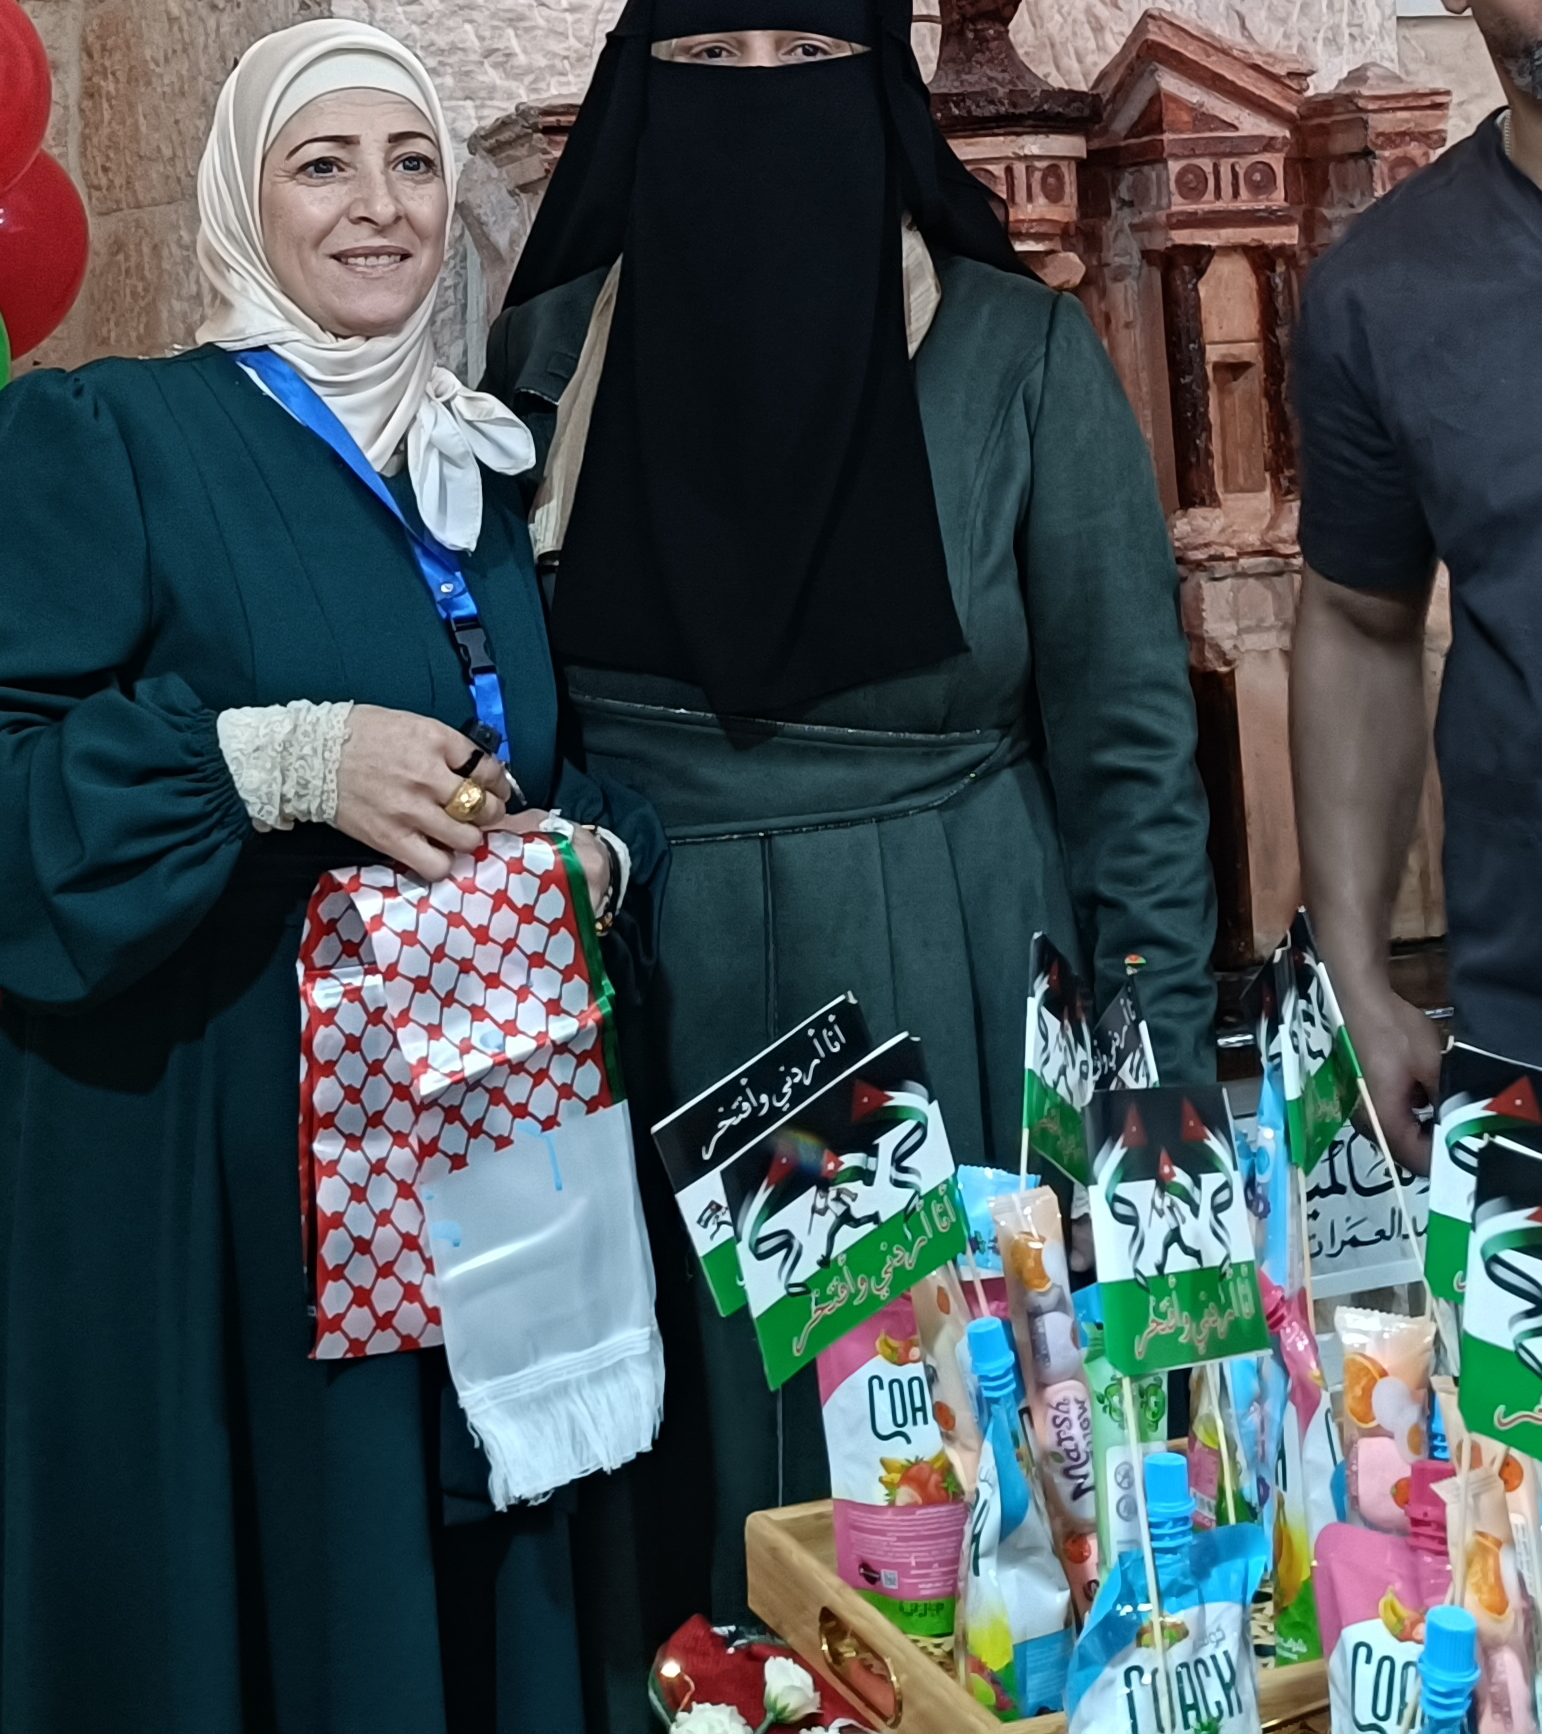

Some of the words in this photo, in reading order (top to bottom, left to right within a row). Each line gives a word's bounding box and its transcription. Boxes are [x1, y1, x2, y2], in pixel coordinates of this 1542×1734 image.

[771, 1027, 825, 1113] أردني
[823, 1013, 847, 1054] أنا
[700, 1077, 772, 1161] وأفتخر
[929, 1181, 957, 1228] أنا
[871, 1203, 934, 1302] أردني
[792, 1252, 869, 1357] وأفتخر
[867, 1373, 930, 1446] COA
